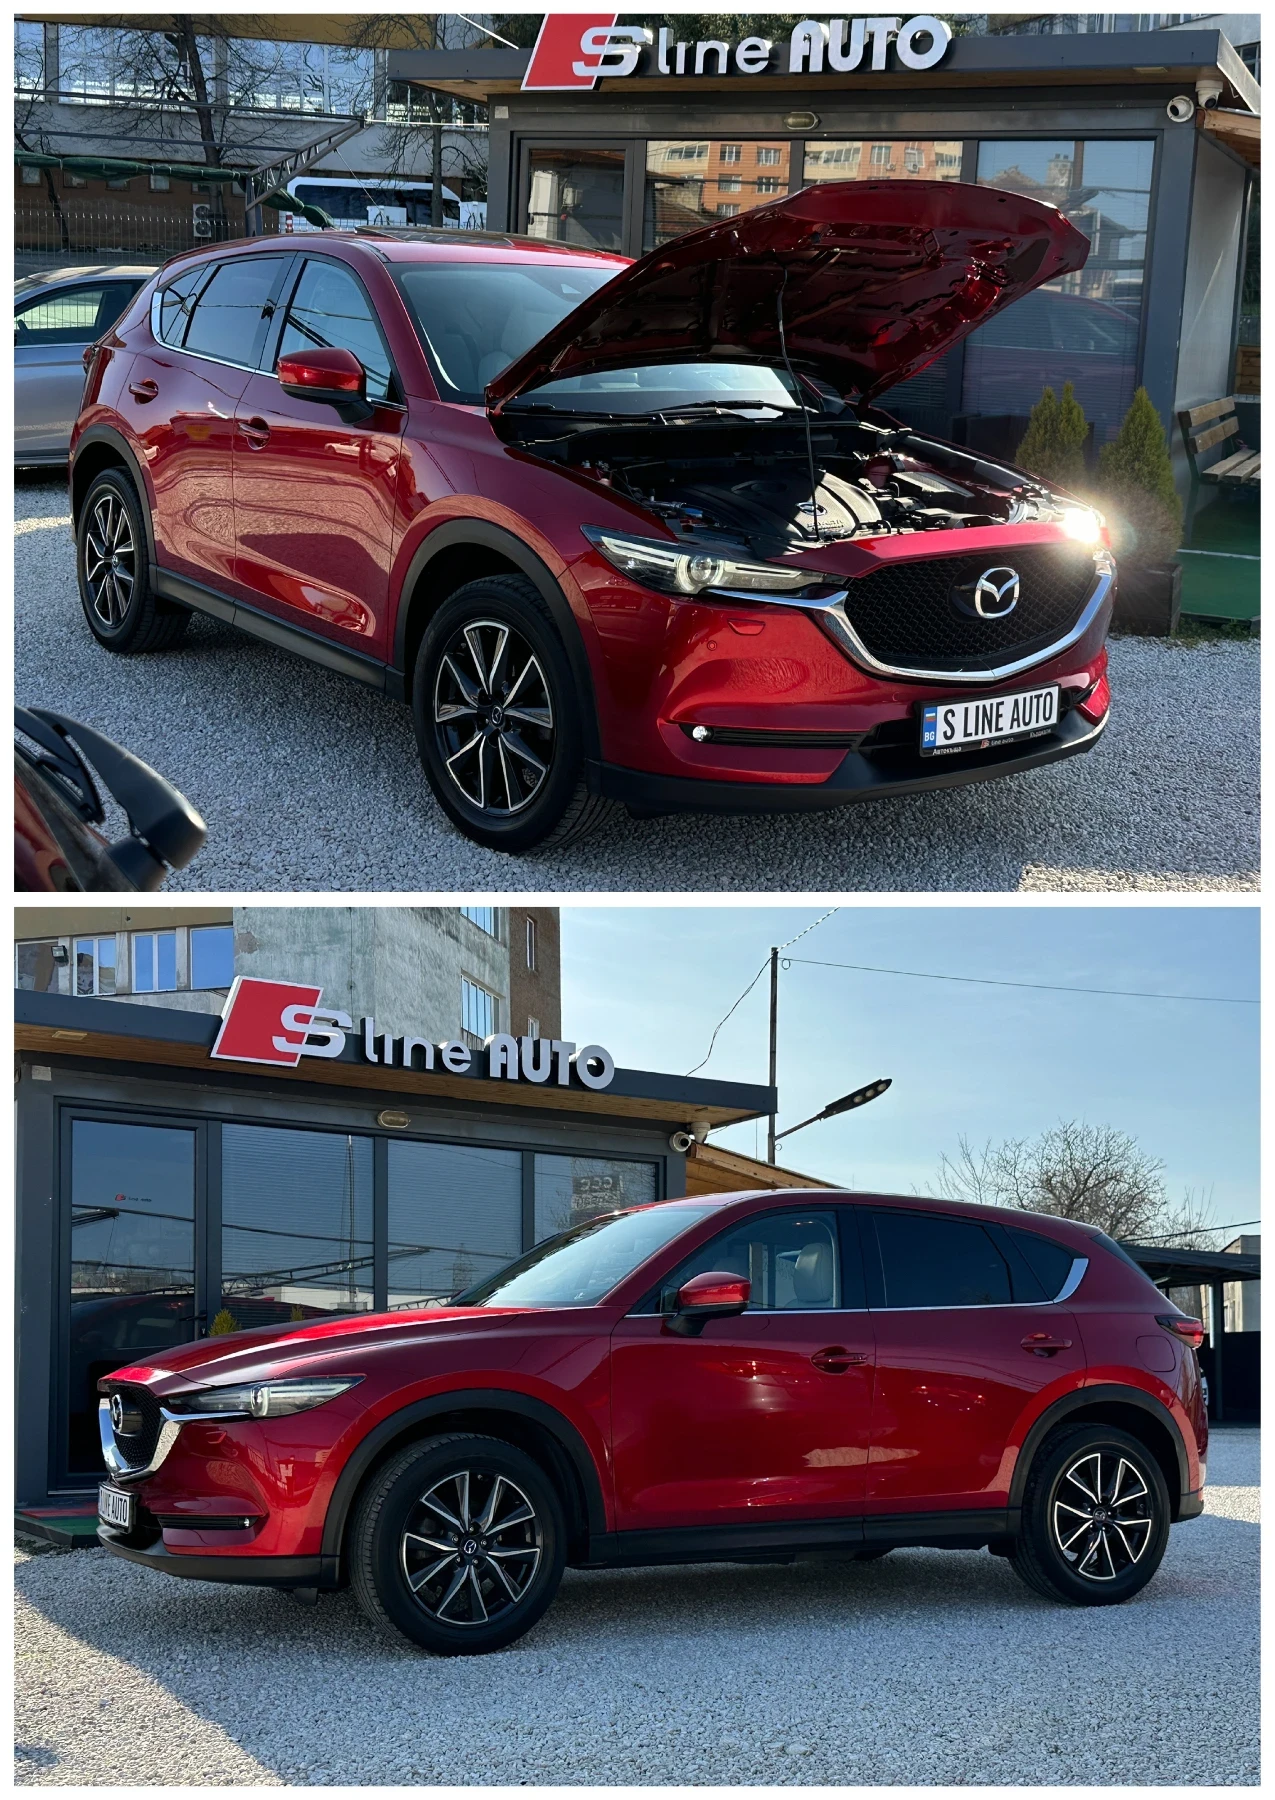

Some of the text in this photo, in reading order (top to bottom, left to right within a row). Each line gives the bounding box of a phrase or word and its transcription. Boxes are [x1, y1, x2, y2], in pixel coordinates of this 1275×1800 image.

[572, 15, 951, 77] S line AUTO
[924, 731, 935, 742] BG
[942, 691, 1053, 741] S LINE AUTO
[272, 1004, 616, 1090] S line AUTO
[112, 1495, 128, 1523] AUTO
